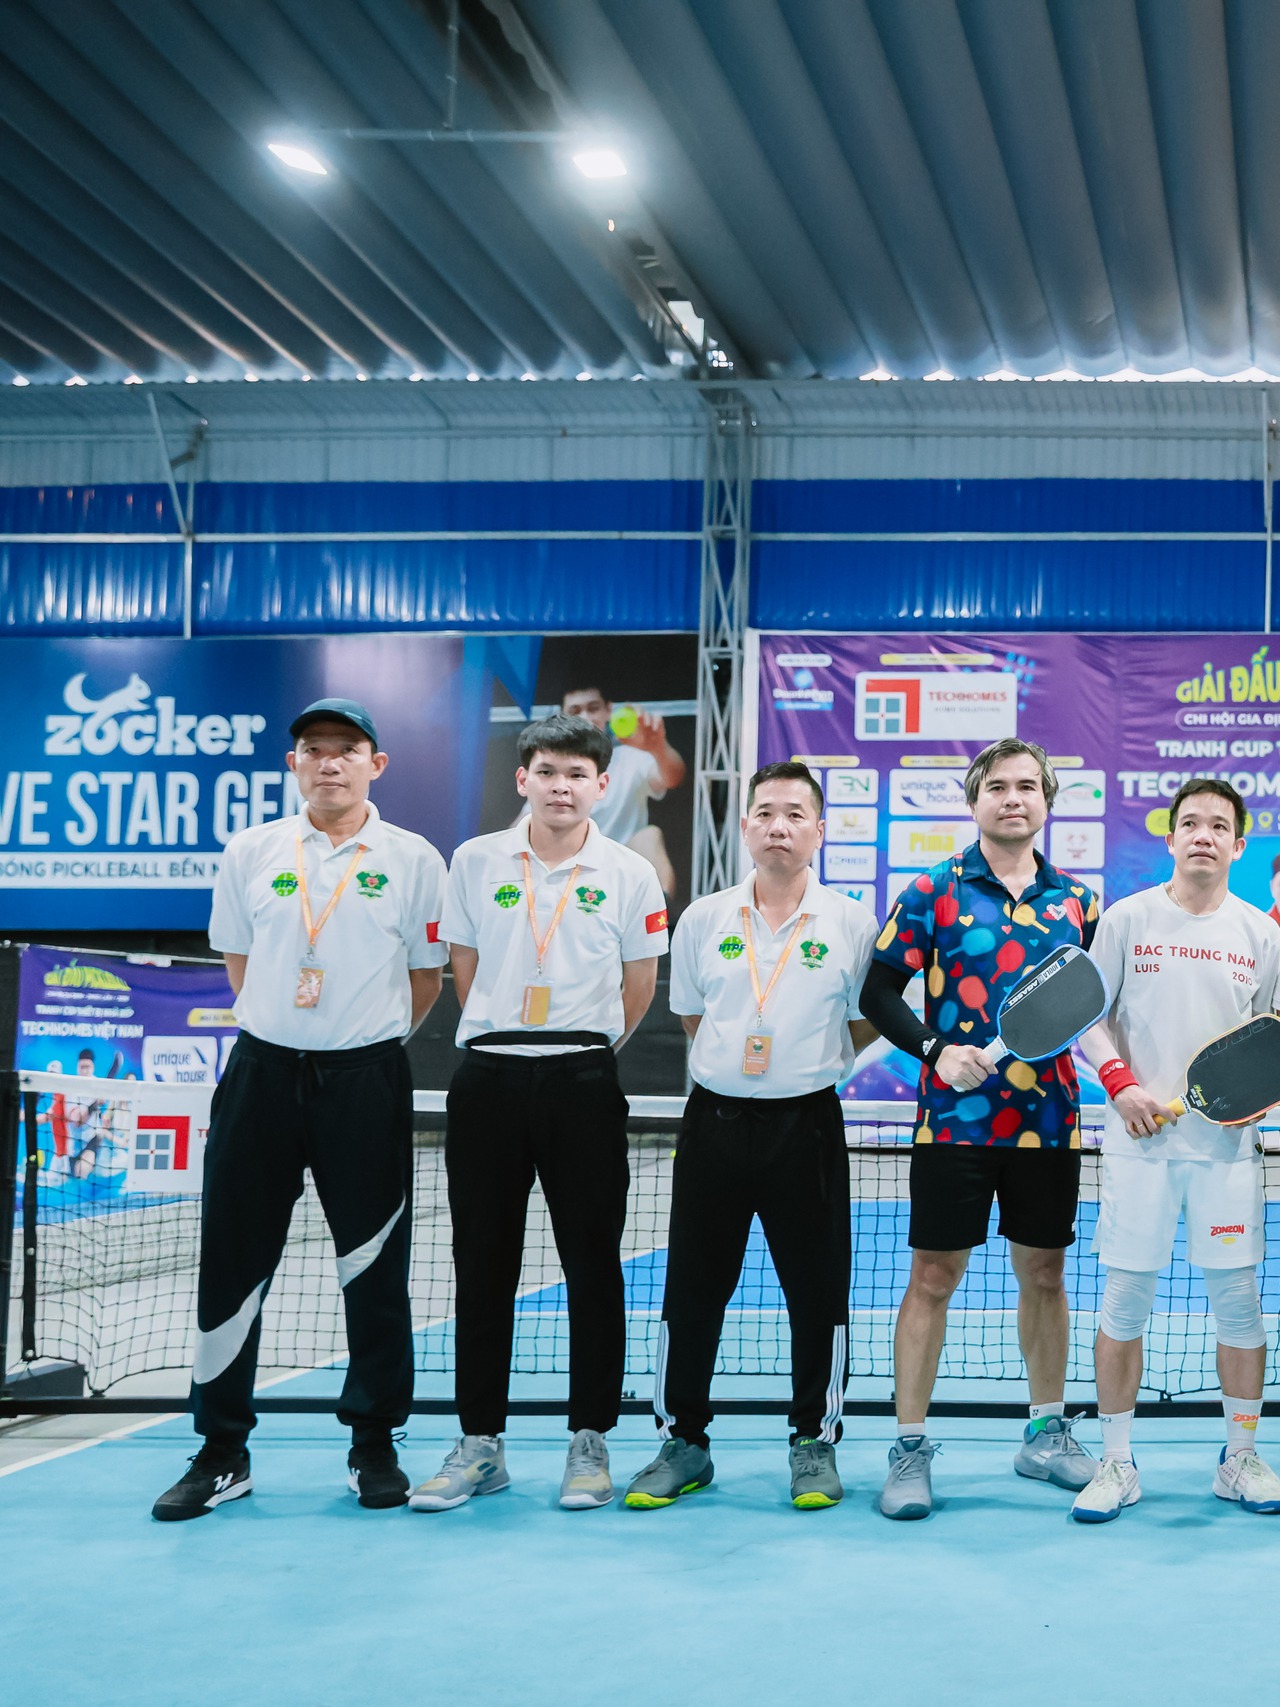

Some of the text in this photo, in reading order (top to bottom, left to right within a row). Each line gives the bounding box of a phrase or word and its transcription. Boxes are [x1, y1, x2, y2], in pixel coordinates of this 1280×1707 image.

[1176, 662, 1225, 703] GIẢI
[44, 696, 267, 756] zocker
[1184, 713, 1208, 726] CHI
[1210, 711, 1235, 727] HỘI
[1237, 713, 1262, 726] GIA
[1155, 740, 1227, 758] TRANH
[1230, 740, 1274, 758] CUP
[900, 779, 946, 794] unique
[65, 771, 199, 846] STAR
[910, 831, 954, 852] Pima
[53, 861, 161, 877] PICKLEBALL
[1134, 945, 1256, 971] BAC TRUNG NAM
[1135, 964, 1160, 973] LUIS
[21, 1020, 94, 1037] TECHHOMES
[117, 1025, 144, 1038] NAM
[154, 1050, 191, 1068] unique
[177, 1068, 207, 1082] house
[1211, 1224, 1245, 1236] ZONZON
